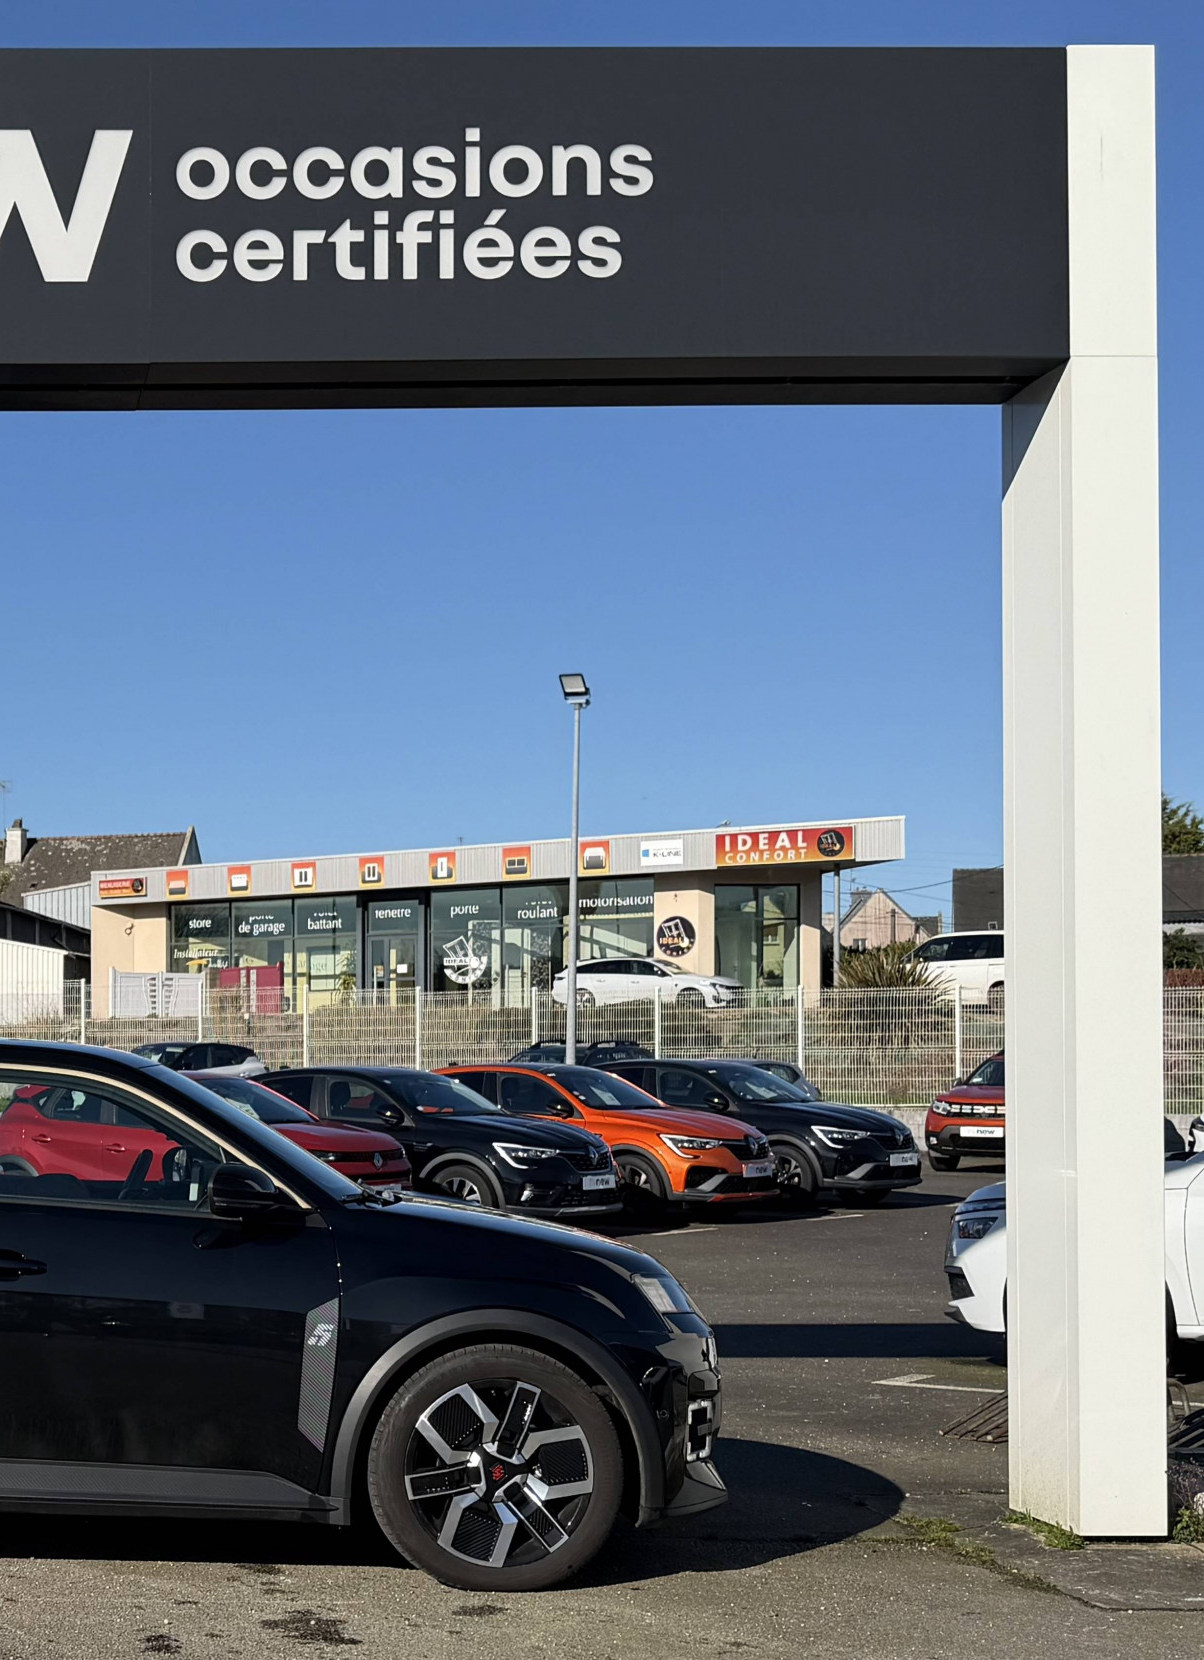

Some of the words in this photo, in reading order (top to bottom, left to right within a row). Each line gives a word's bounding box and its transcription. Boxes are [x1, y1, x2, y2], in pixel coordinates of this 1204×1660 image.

[176, 127, 654, 200] occasions
[176, 208, 623, 282] certifiées
[724, 831, 808, 852] IDEAL
[724, 849, 807, 863] CONFORT
[517, 906, 558, 919] roulant
[188, 918, 212, 929] store
[239, 923, 251, 933] de
[253, 924, 286, 936] garage
[307, 917, 343, 930] battant
